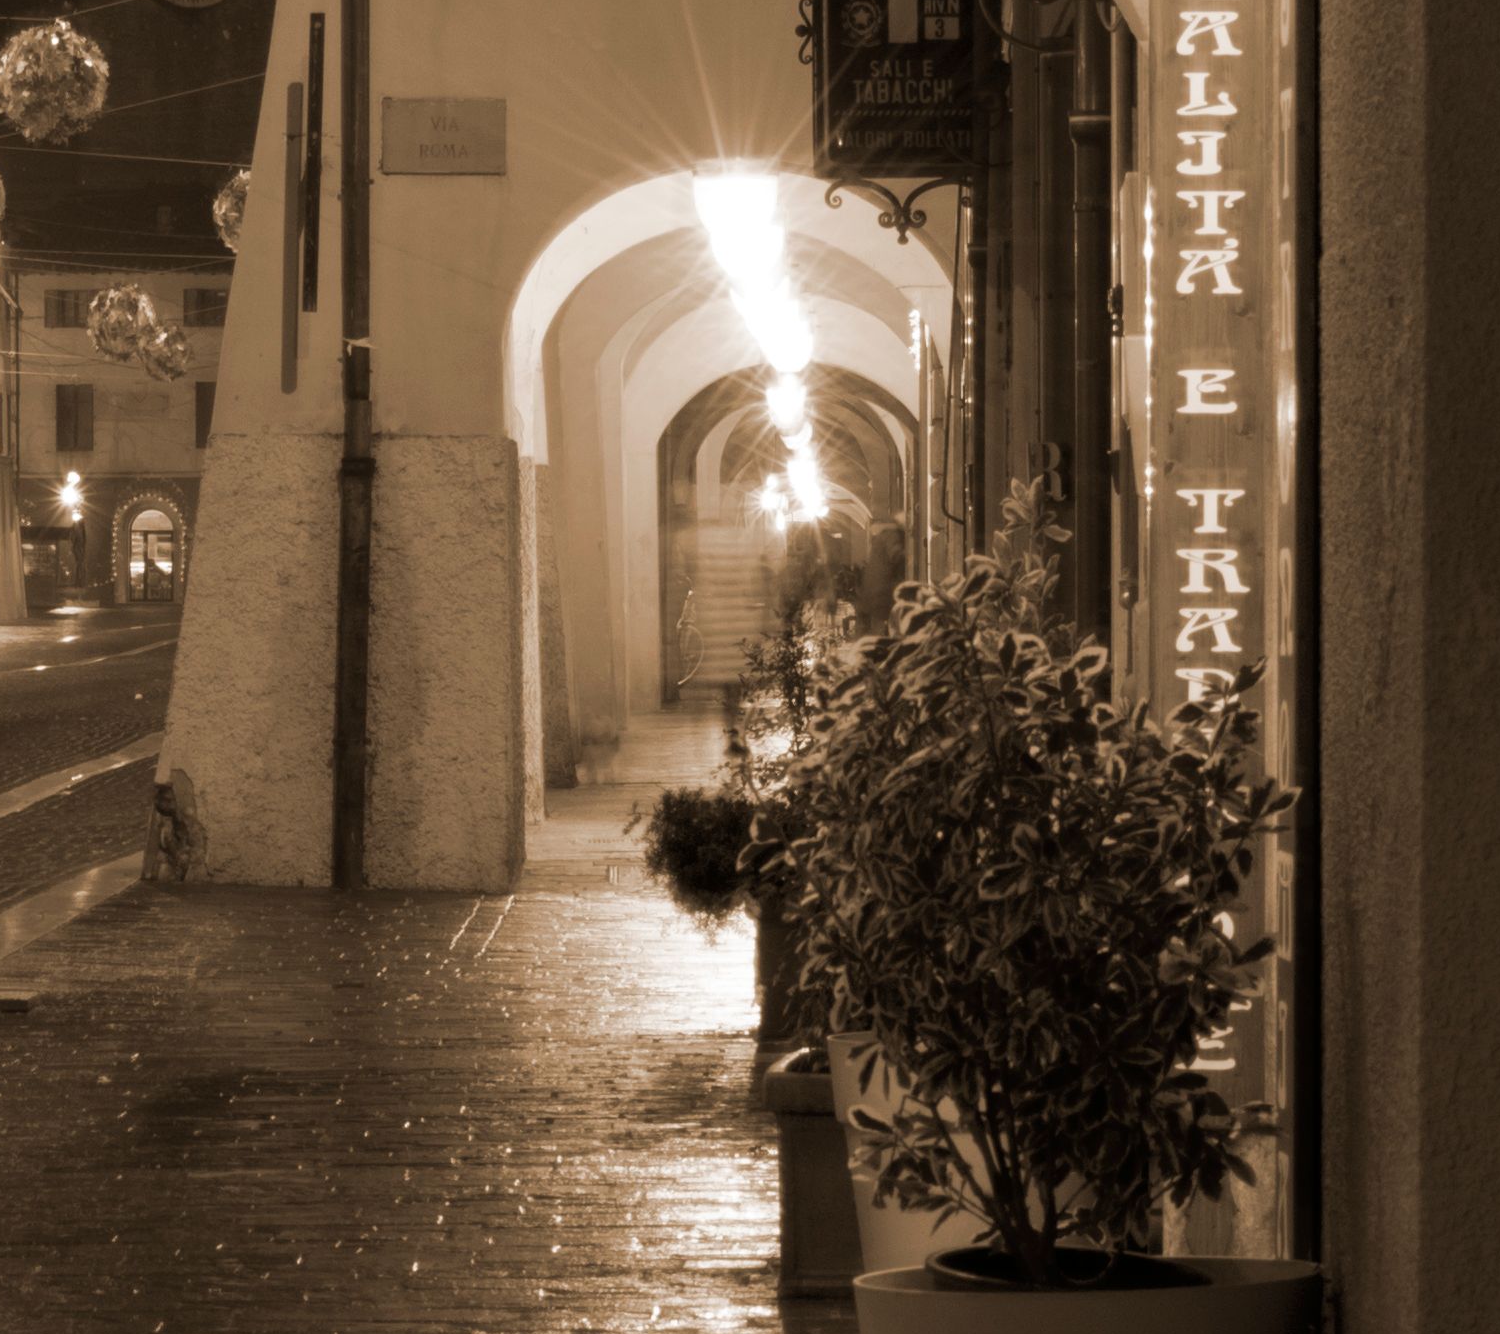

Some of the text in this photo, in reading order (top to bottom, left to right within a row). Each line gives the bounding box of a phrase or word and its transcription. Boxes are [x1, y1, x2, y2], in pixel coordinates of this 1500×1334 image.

[935, 18, 945, 38] 3
[869, 59, 934, 78] SALI E
[853, 79, 953, 104] TABACCHI
[1176, 369, 1238, 414] E
